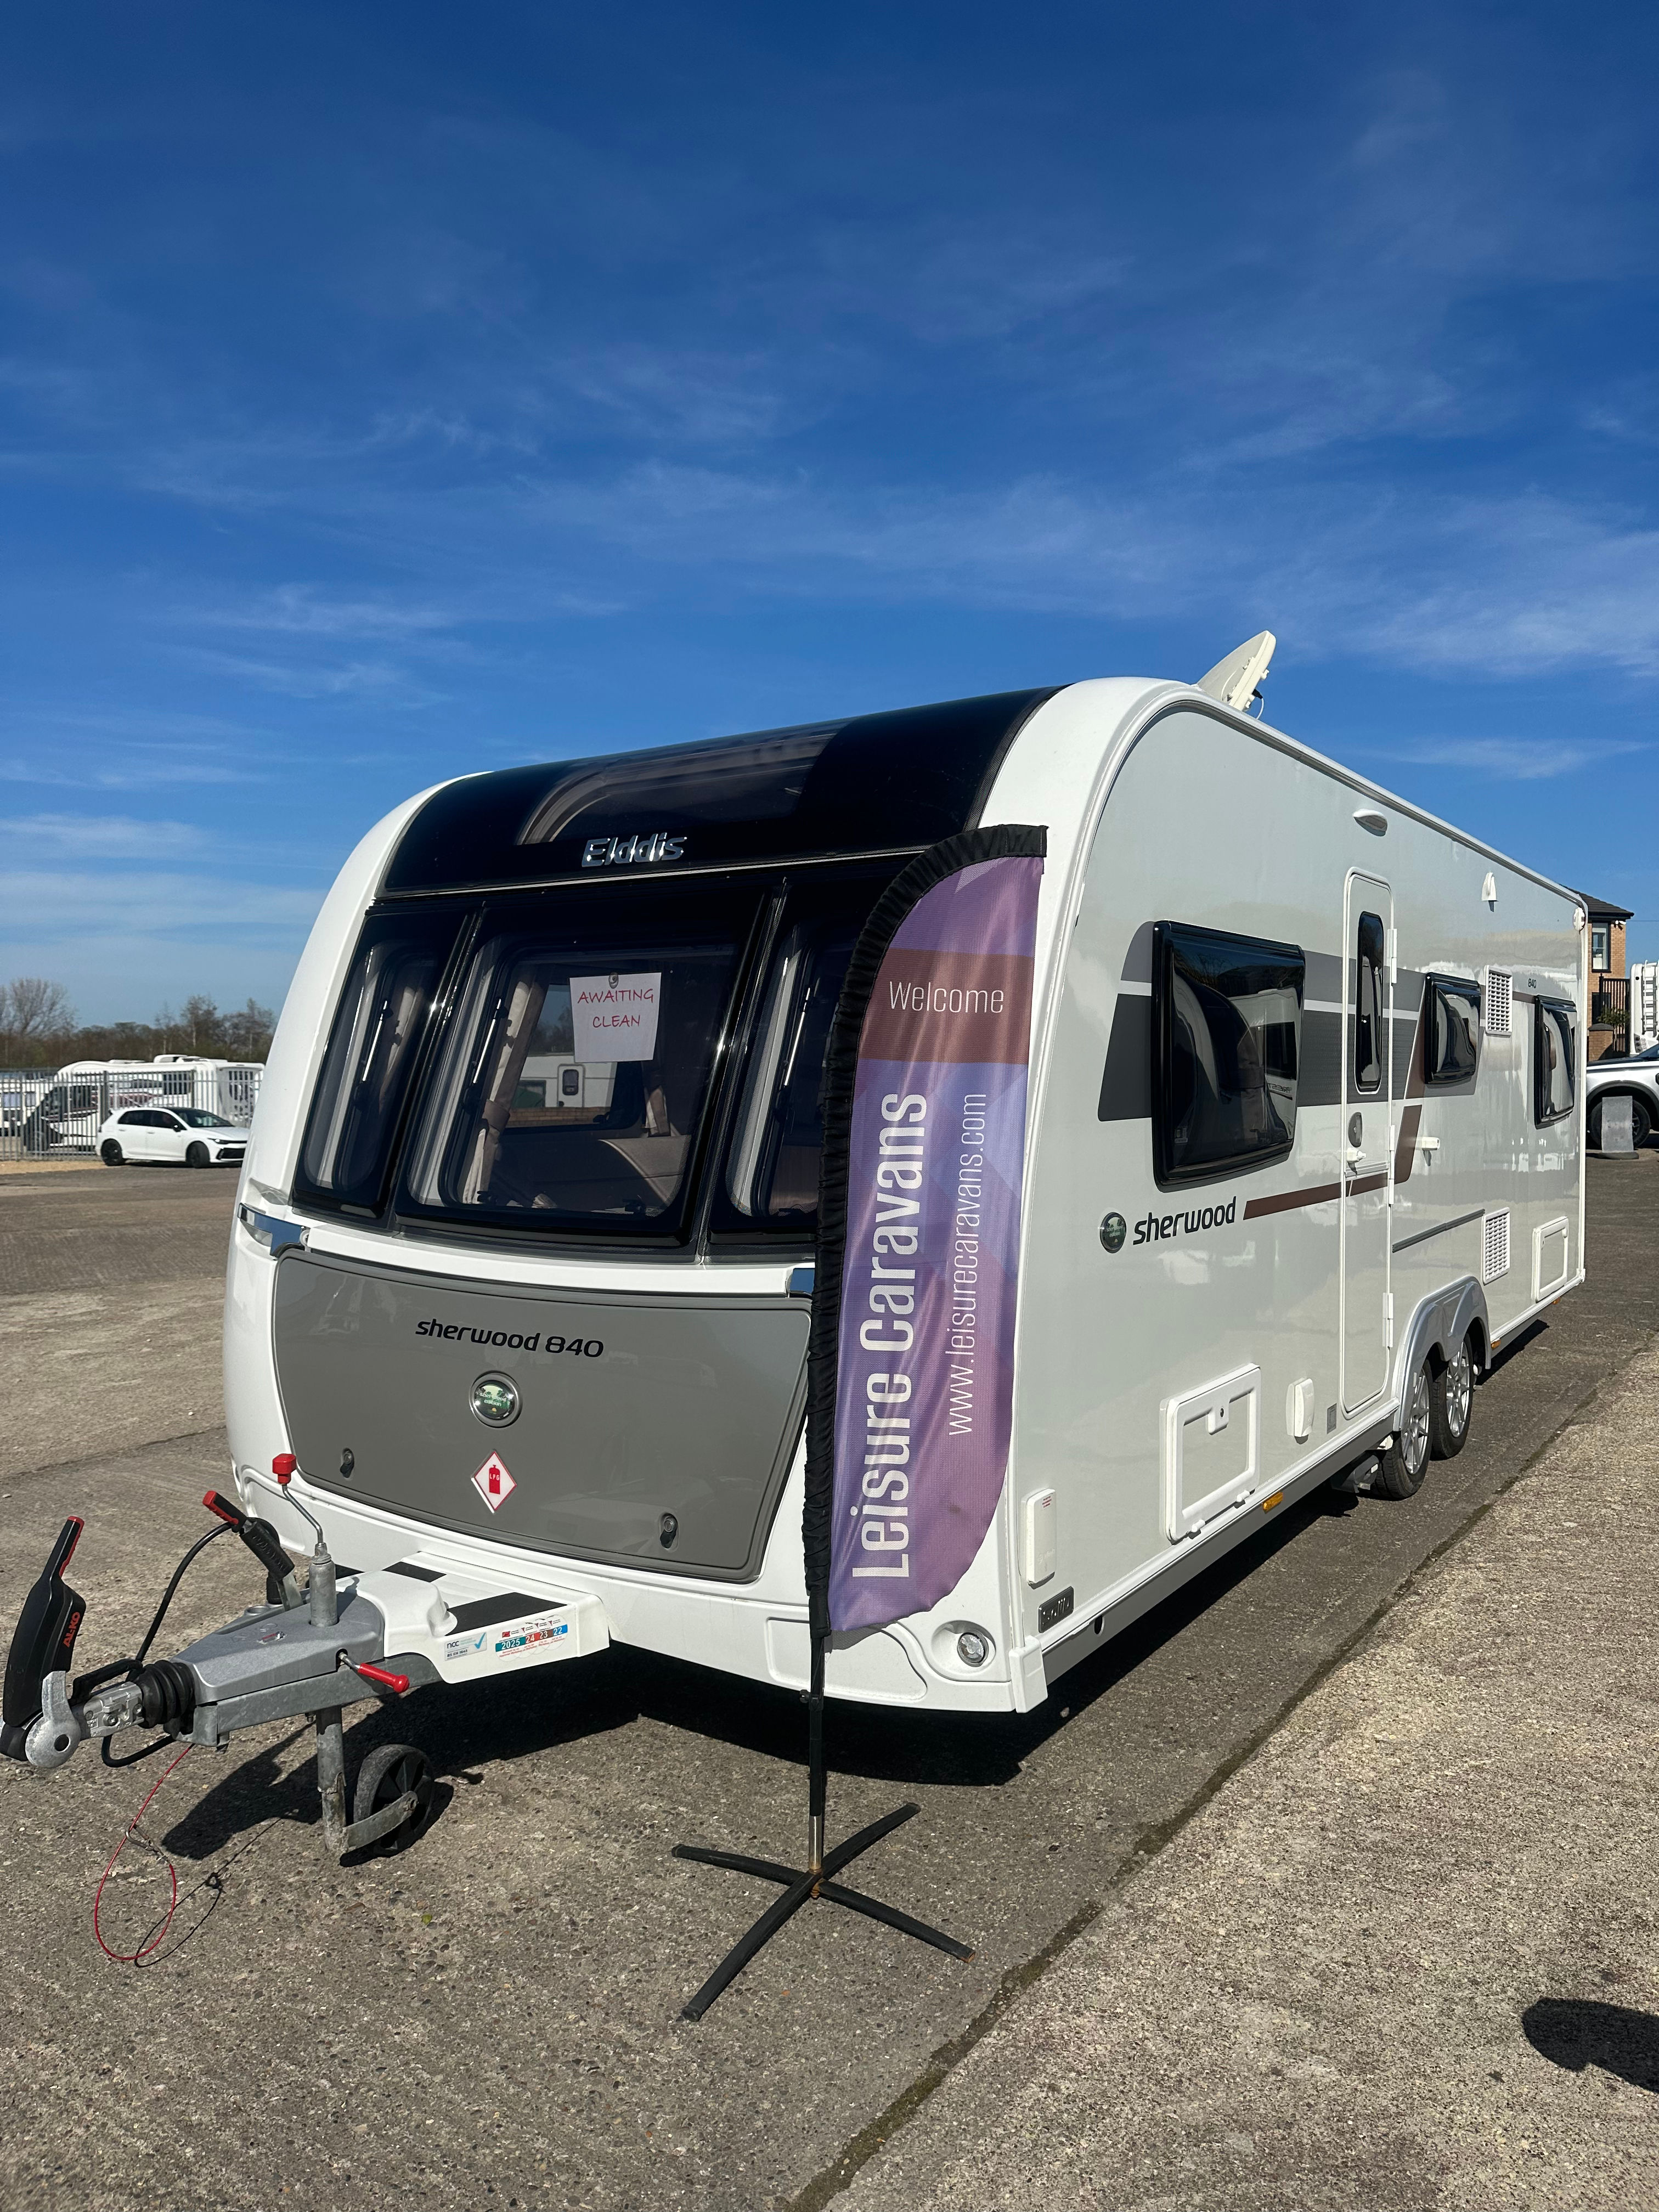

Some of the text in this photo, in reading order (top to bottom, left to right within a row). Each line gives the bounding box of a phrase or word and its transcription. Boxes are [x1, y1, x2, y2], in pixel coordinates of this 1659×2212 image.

[582, 832, 687, 867] Elddis
[577, 989, 654, 1004] AWAITING
[889, 981, 1005, 1014] Welcome
[1528, 978, 1537, 989] 840
[592, 1014, 640, 1028] CLEAN
[1132, 1196, 1237, 1245] sherwood
[945, 1093, 986, 1436] www.leisurecaravans.com
[415, 1318, 604, 1358] sherwood 840
[852, 1093, 927, 1577] Leisure Caravans
[63, 1612, 81, 1648] AL-KO
[447, 1640, 460, 1649] ncc
[501, 1639, 520, 1650] 2025
[526, 1634, 535, 1644] 24
[539, 1630, 548, 1639] 23
[554, 1627, 563, 1636] 22
